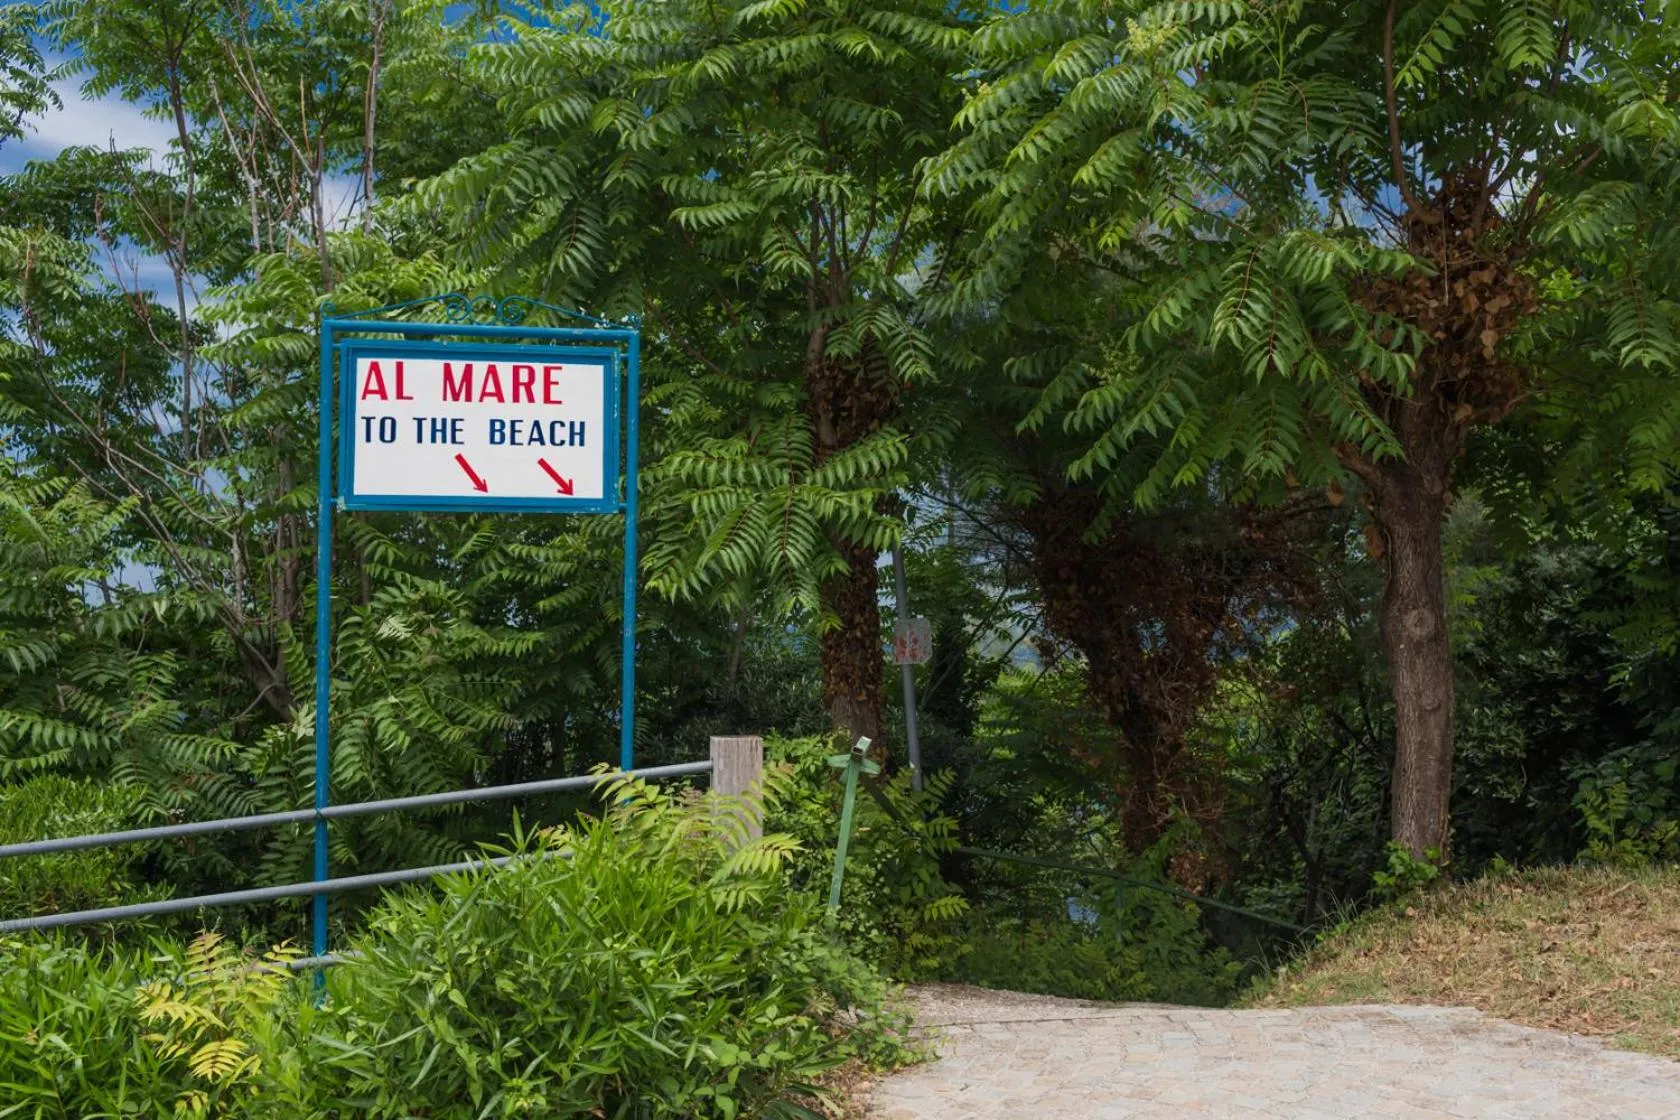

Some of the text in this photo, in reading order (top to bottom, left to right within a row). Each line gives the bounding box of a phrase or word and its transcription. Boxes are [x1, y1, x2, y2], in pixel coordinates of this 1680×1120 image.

[361, 360, 563, 405] AL MARE
[360, 416, 586, 447] TO THE BEACH
